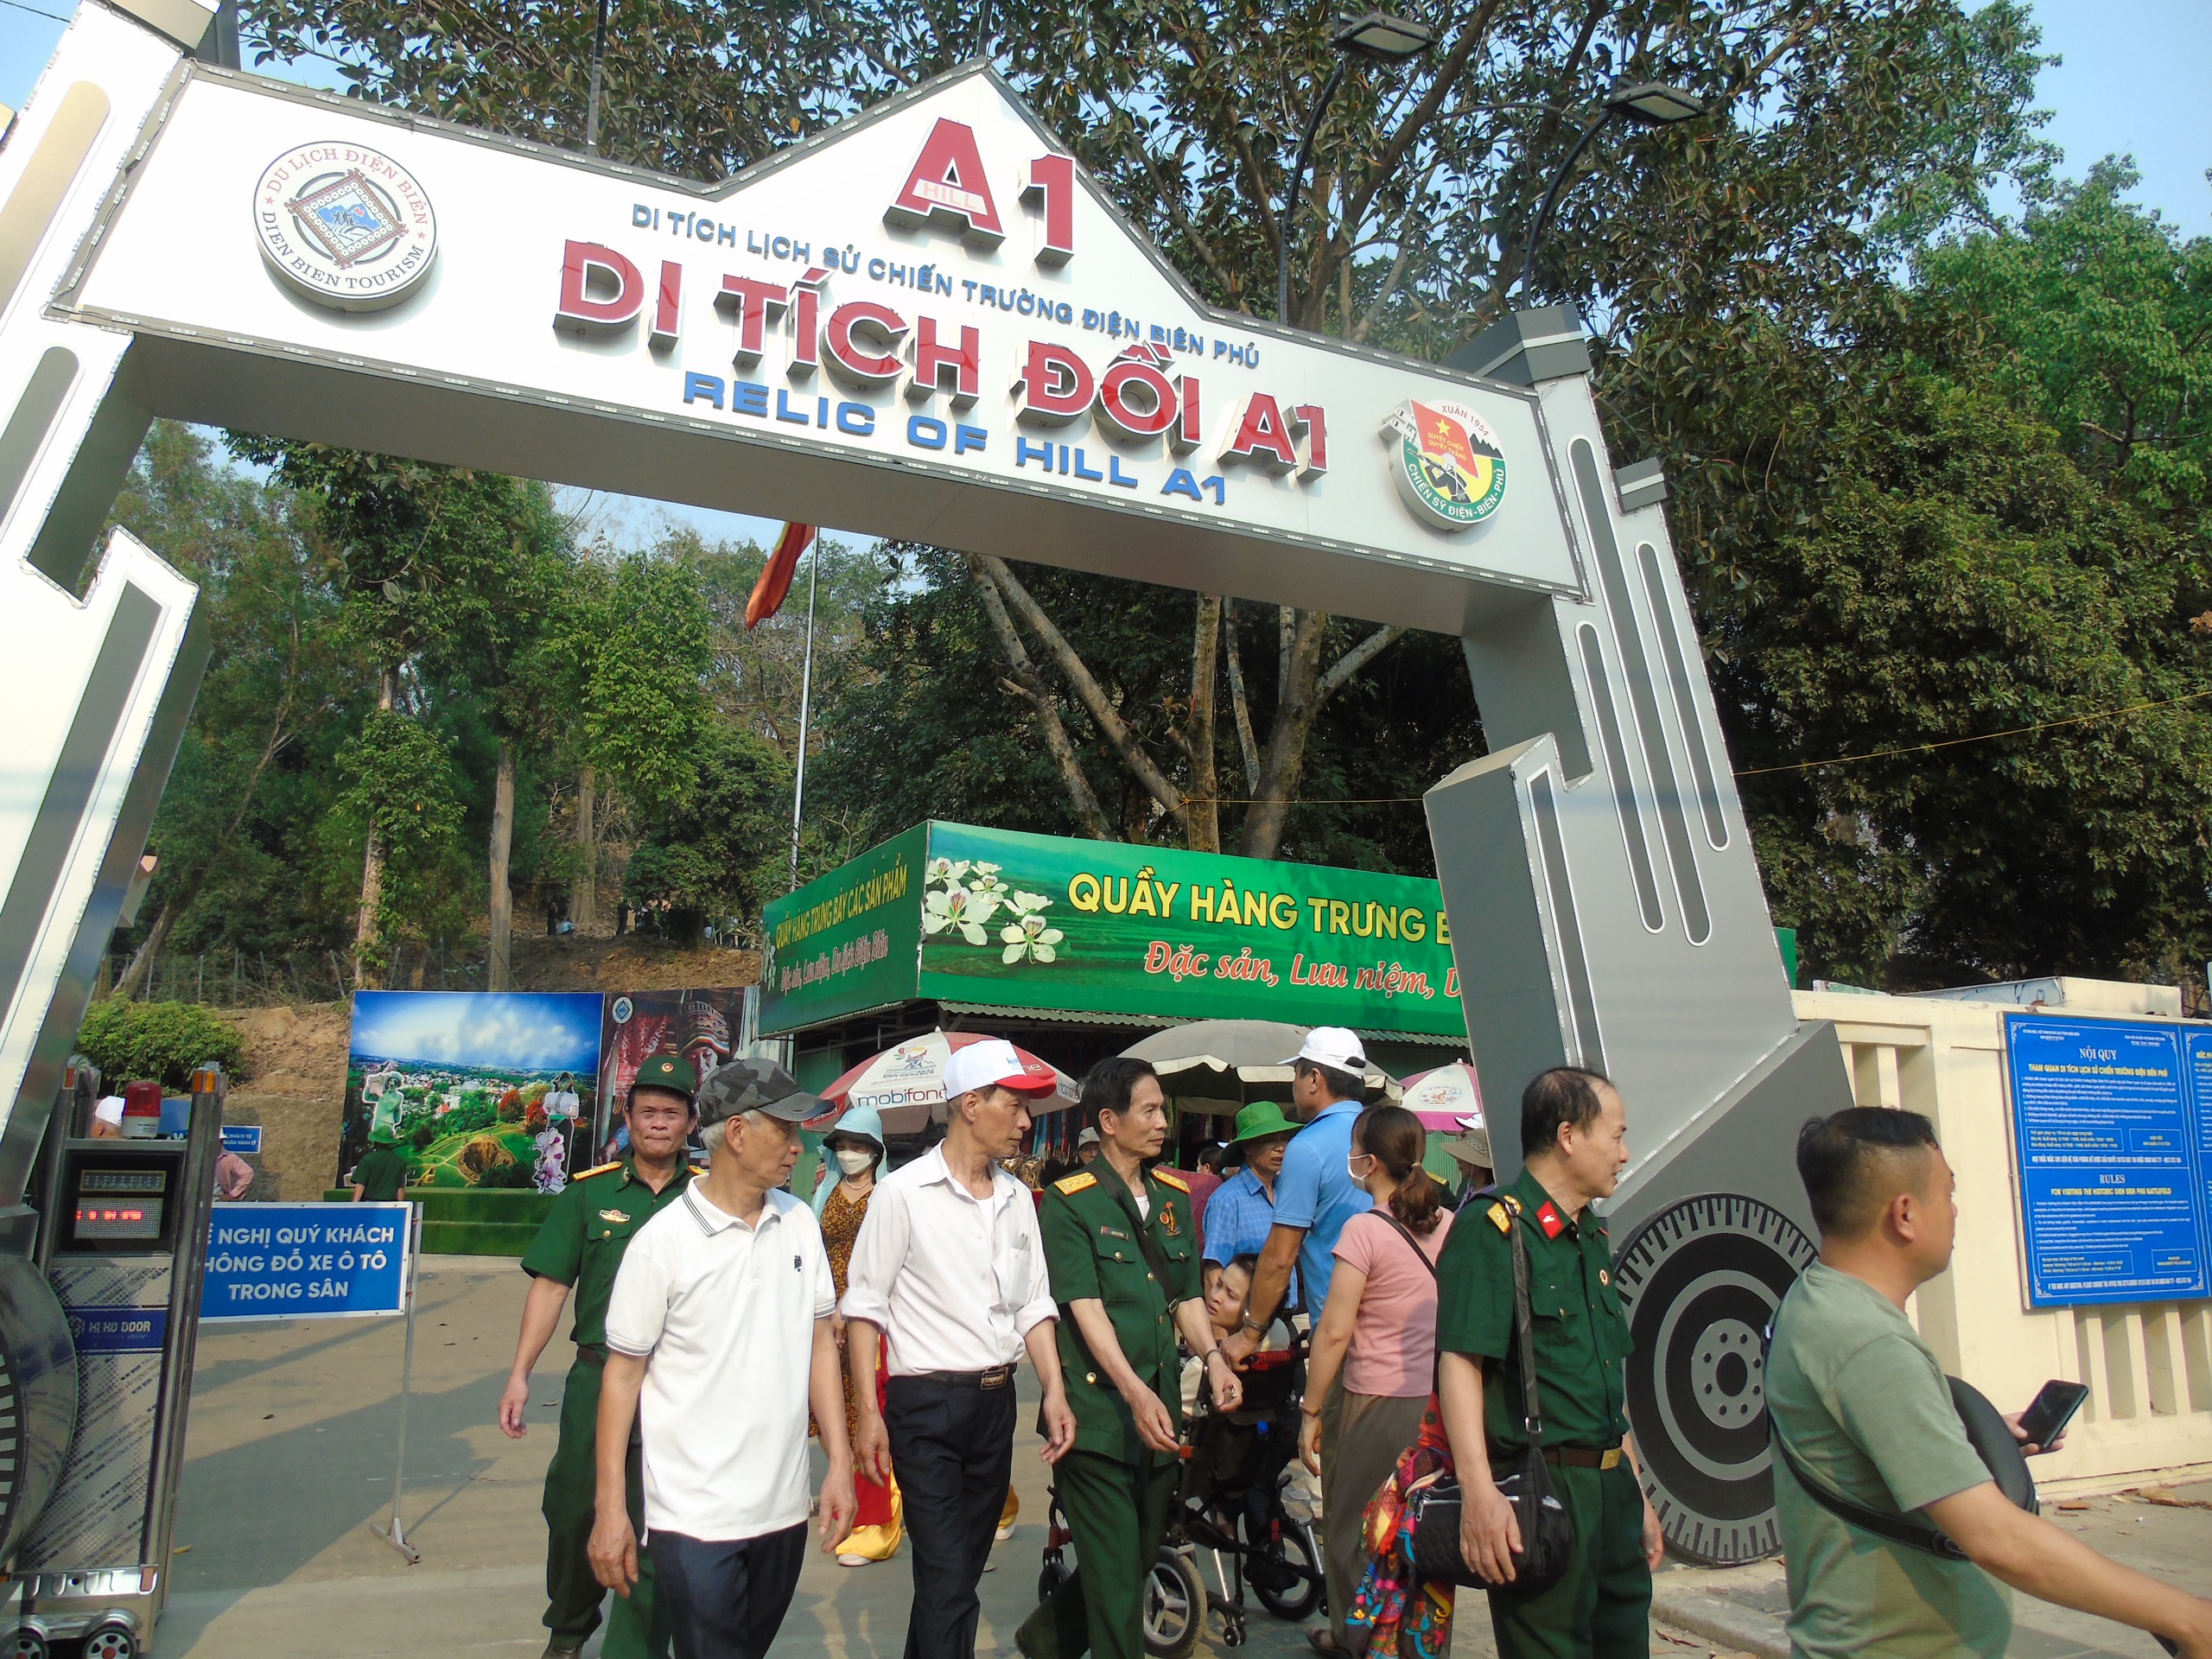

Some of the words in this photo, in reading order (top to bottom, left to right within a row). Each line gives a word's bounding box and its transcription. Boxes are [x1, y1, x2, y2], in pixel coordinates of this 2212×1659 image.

[266, 168, 289, 194] DU
[288, 148, 339, 171] LỊCH
[345, 149, 398, 180] ĐIỆN
[397, 180, 428, 226] BIÊN
[887, 116, 1076, 257] A1
[923, 182, 977, 210] HILL
[262, 211, 294, 257] DIEN
[290, 257, 340, 287] BIEN
[345, 244, 424, 289] TOURISM
[632, 204, 659, 230] DI
[668, 212, 736, 247] TÍCH
[747, 230, 810, 264] LỊCH
[823, 244, 861, 273] SỬ
[868, 264, 952, 296] CHIẾN
[962, 280, 1073, 324] TRƯỜNG
[1084, 308, 1140, 339] ĐIỆN
[1150, 324, 1205, 357] BIÊN
[1213, 342, 1260, 369] PHỦ
[557, 238, 682, 344] DI
[719, 267, 980, 401] TÍCH
[1020, 340, 1202, 446] ĐỒI
[1227, 390, 1328, 474] A1
[683, 371, 875, 435] RELIC
[907, 415, 988, 454] OF
[1016, 436, 1138, 488] HILL
[1160, 468, 1225, 505] A1
[1441, 404, 1468, 419] XUÂN
[1470, 416, 1490, 436] 1954
[1408, 463, 1433, 500] CHIẾN
[791, 908, 810, 943] HÀNG
[811, 899, 833, 934] TRƯNG
[848, 878, 864, 918] CÁC
[866, 868, 881, 912] SẢN
[882, 852, 907, 904] PHẨM
[1068, 865, 1180, 918] QUẦY
[1191, 878, 1298, 930] HÀNG
[1307, 897, 1427, 943] TRƯNG
[1144, 941, 1209, 982] Đặc
[1215, 947, 1280, 988] sản,
[1290, 953, 1349, 989] Lưu
[1354, 961, 1435, 999] niệm,
[2079, 1046, 2096, 1061] NỘI
[2098, 1048, 2117, 1062] QUY
[2099, 1174, 2126, 1184] RULES
[219, 1228, 270, 1249] NGHỊ
[276, 1224, 321, 1244] QUÝ
[326, 1224, 394, 1243] KHÁCH
[205, 1252, 264, 1273] HÔNG
[271, 1248, 303, 1271] ĐỖ
[308, 1255, 333, 1270] XE
[338, 1249, 354, 1270] Ô
[359, 1249, 387, 1270] TÔ
[229, 1282, 302, 1300] TRONG
[308, 1278, 348, 1298] SÂN
[121, 1320, 151, 1332] DOOR
